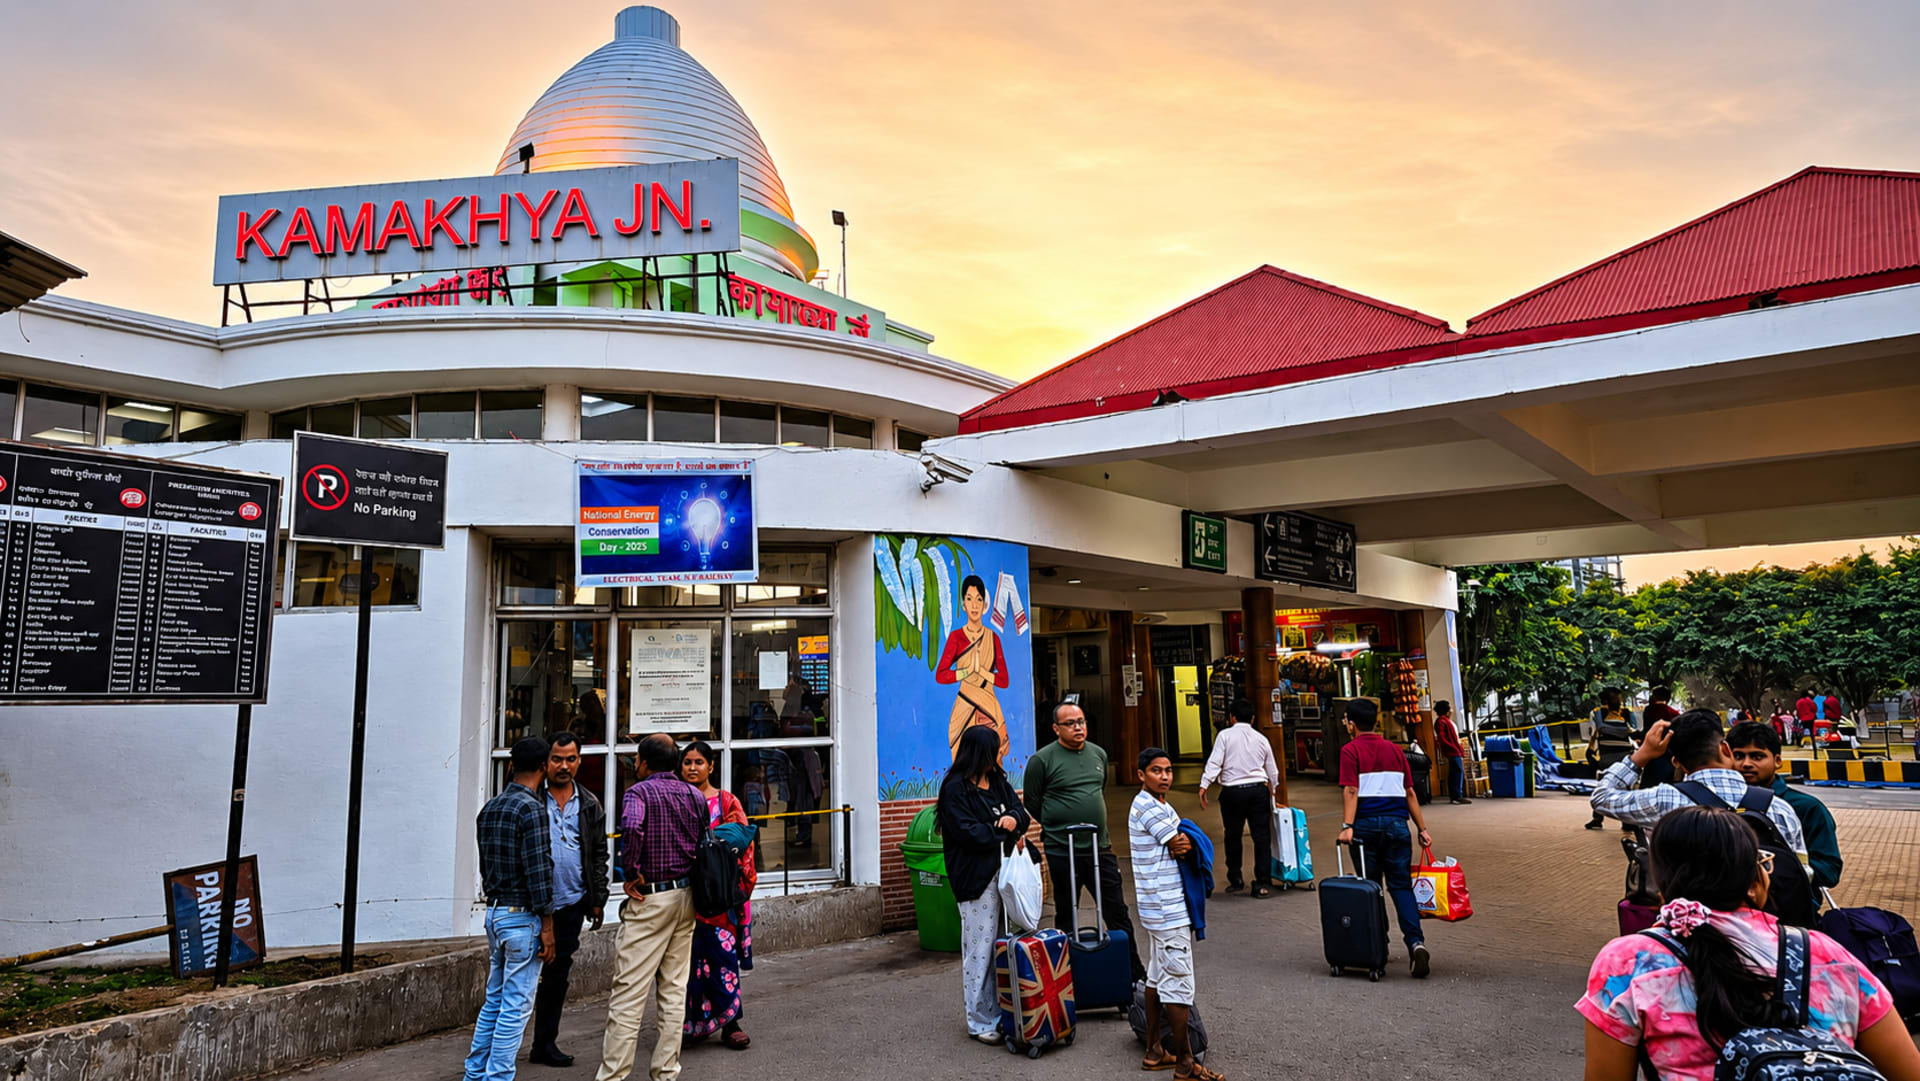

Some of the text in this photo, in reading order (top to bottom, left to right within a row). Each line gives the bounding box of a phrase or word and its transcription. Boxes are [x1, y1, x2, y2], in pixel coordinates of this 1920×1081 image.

[235, 180, 711, 262] KAMAKHYA JN.
[353, 502, 417, 521] No Parking
[583, 509, 655, 520] National Energy
[588, 526, 650, 536] Conservation
[600, 542, 617, 554] Day
[625, 541, 647, 551] 2025
[603, 575, 654, 584] ELECTRICAL
[233, 897, 253, 929] NO
